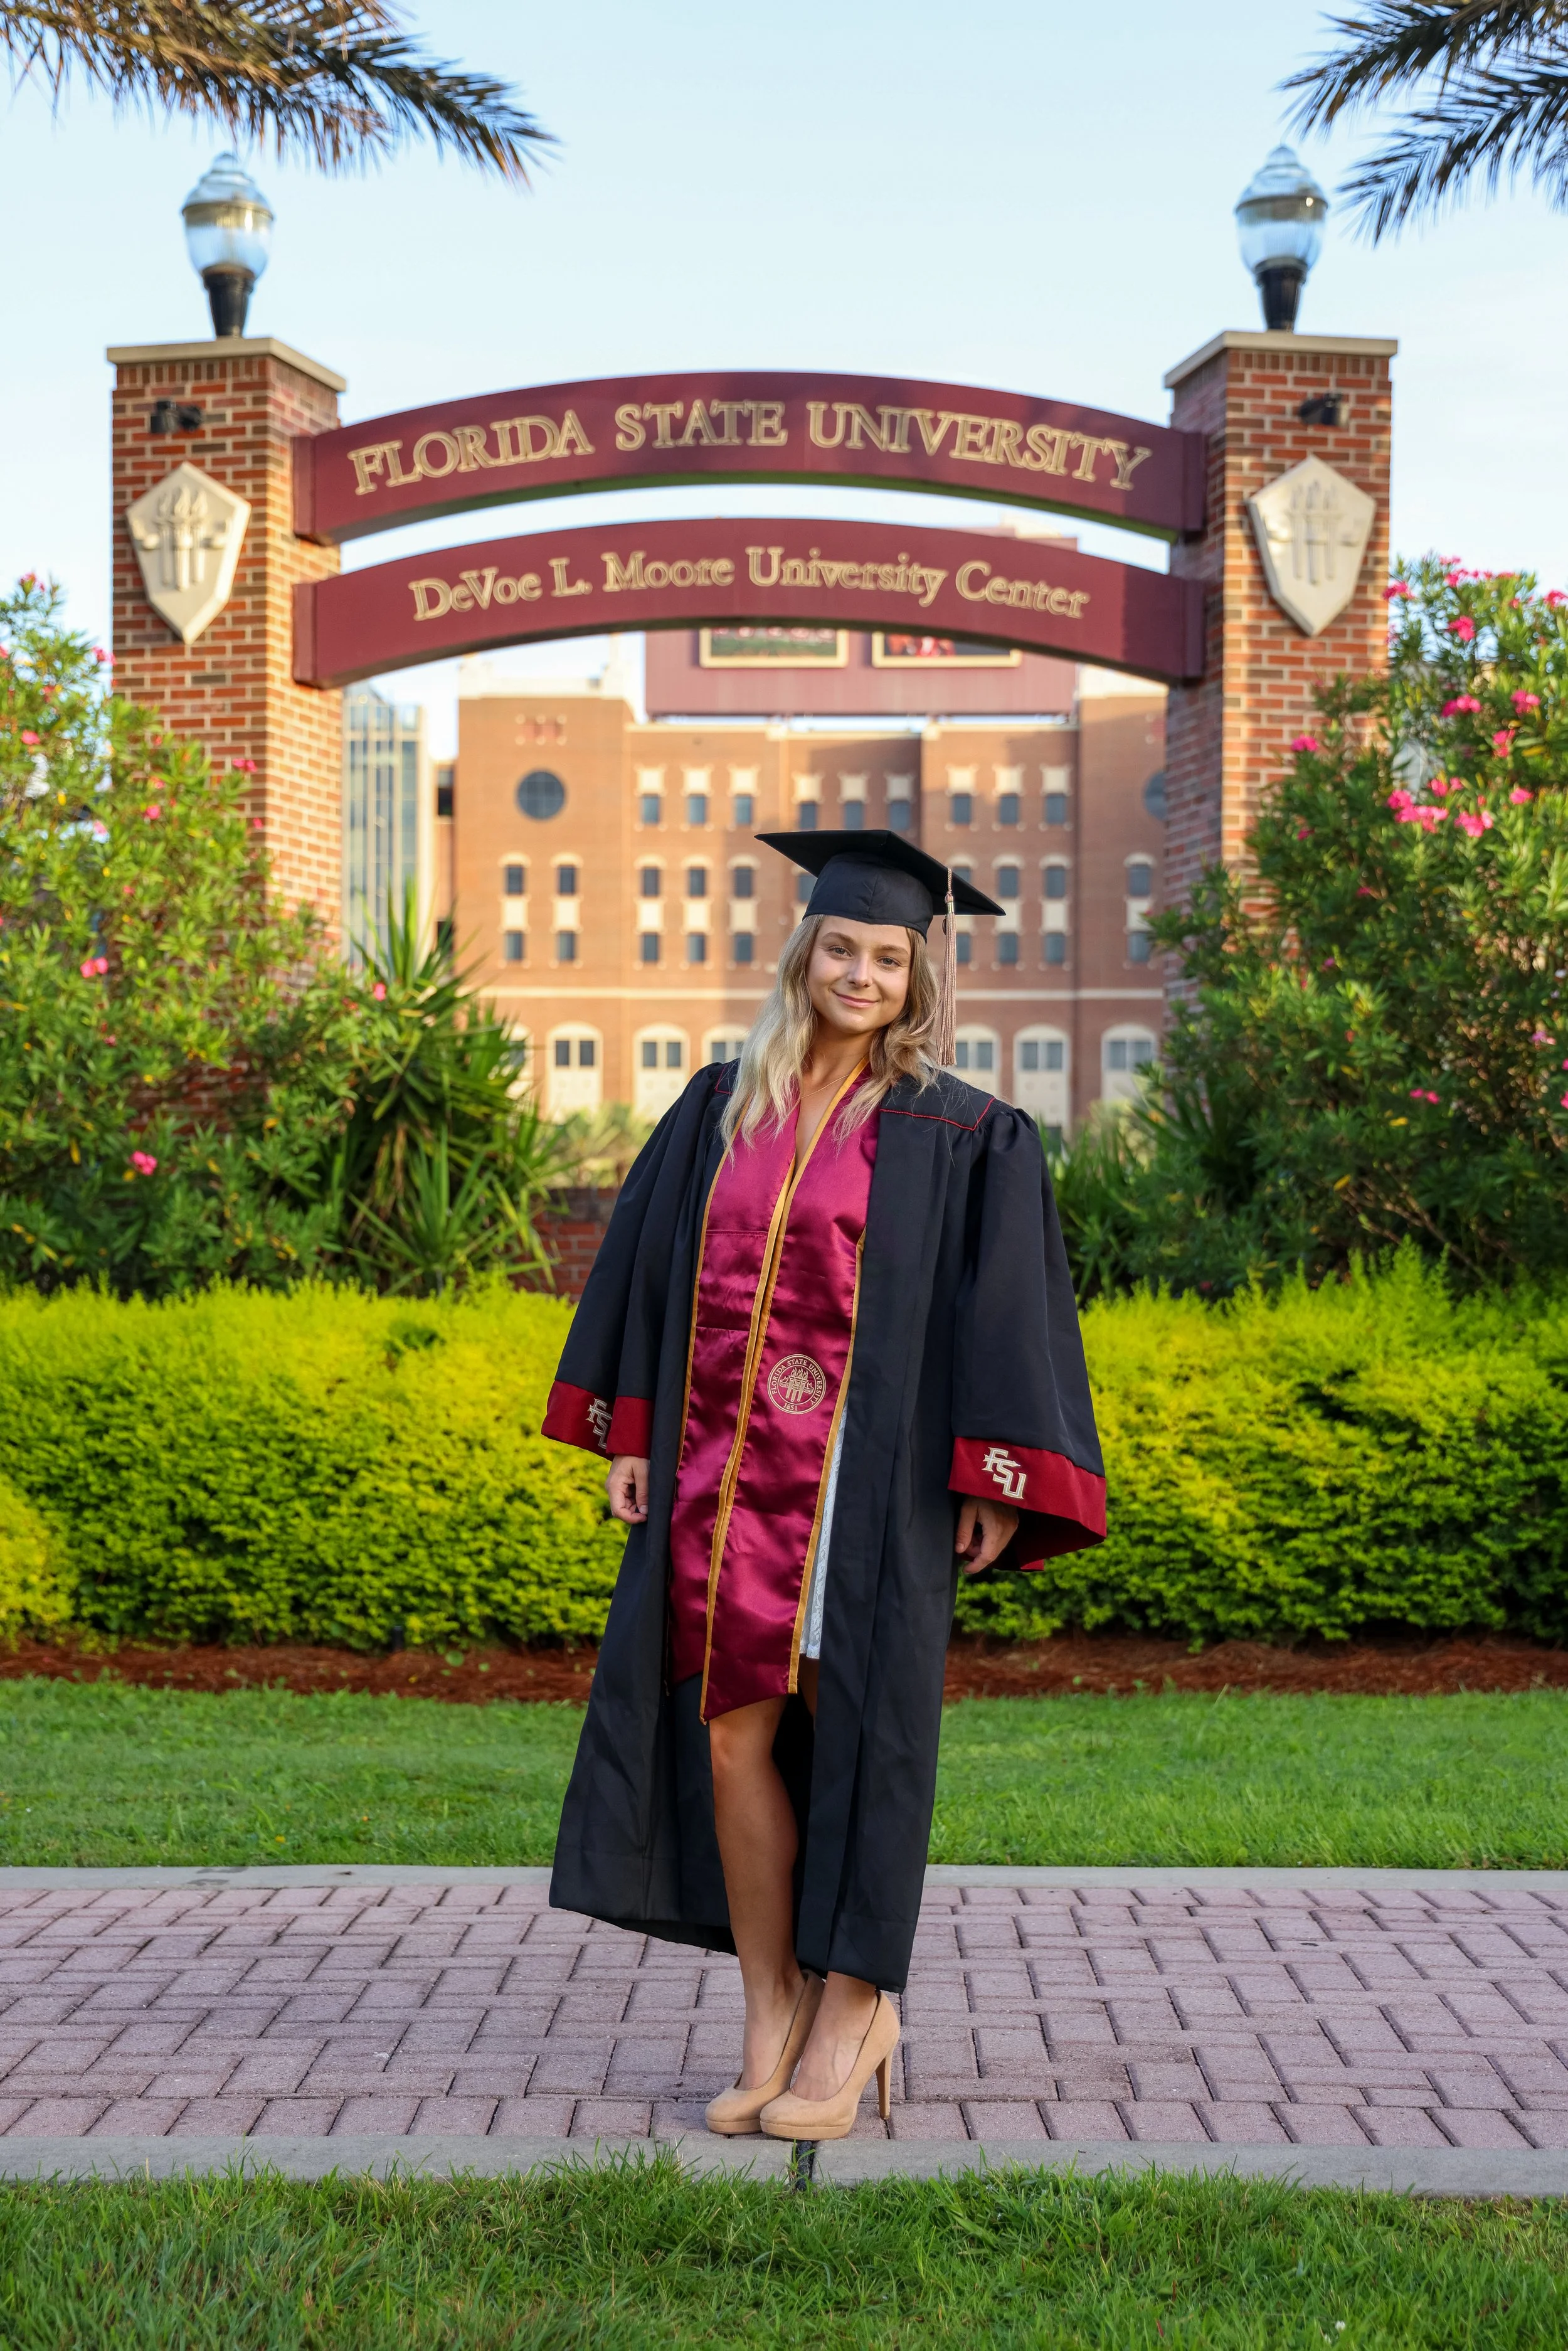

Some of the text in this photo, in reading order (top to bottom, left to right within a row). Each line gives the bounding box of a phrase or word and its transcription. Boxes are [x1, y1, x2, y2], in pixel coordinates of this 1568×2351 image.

[347, 400, 1152, 495] FLORIDA STATE UNIVERSITY
[408, 546, 1090, 621] DeVoe L. Moore University Center
[771, 1364, 787, 1395] FLORIDA
[809, 1364, 822, 1405] UNIVERSITY
[783, 1403, 798, 1411] 1851
[981, 1447, 1027, 1500] FSU
